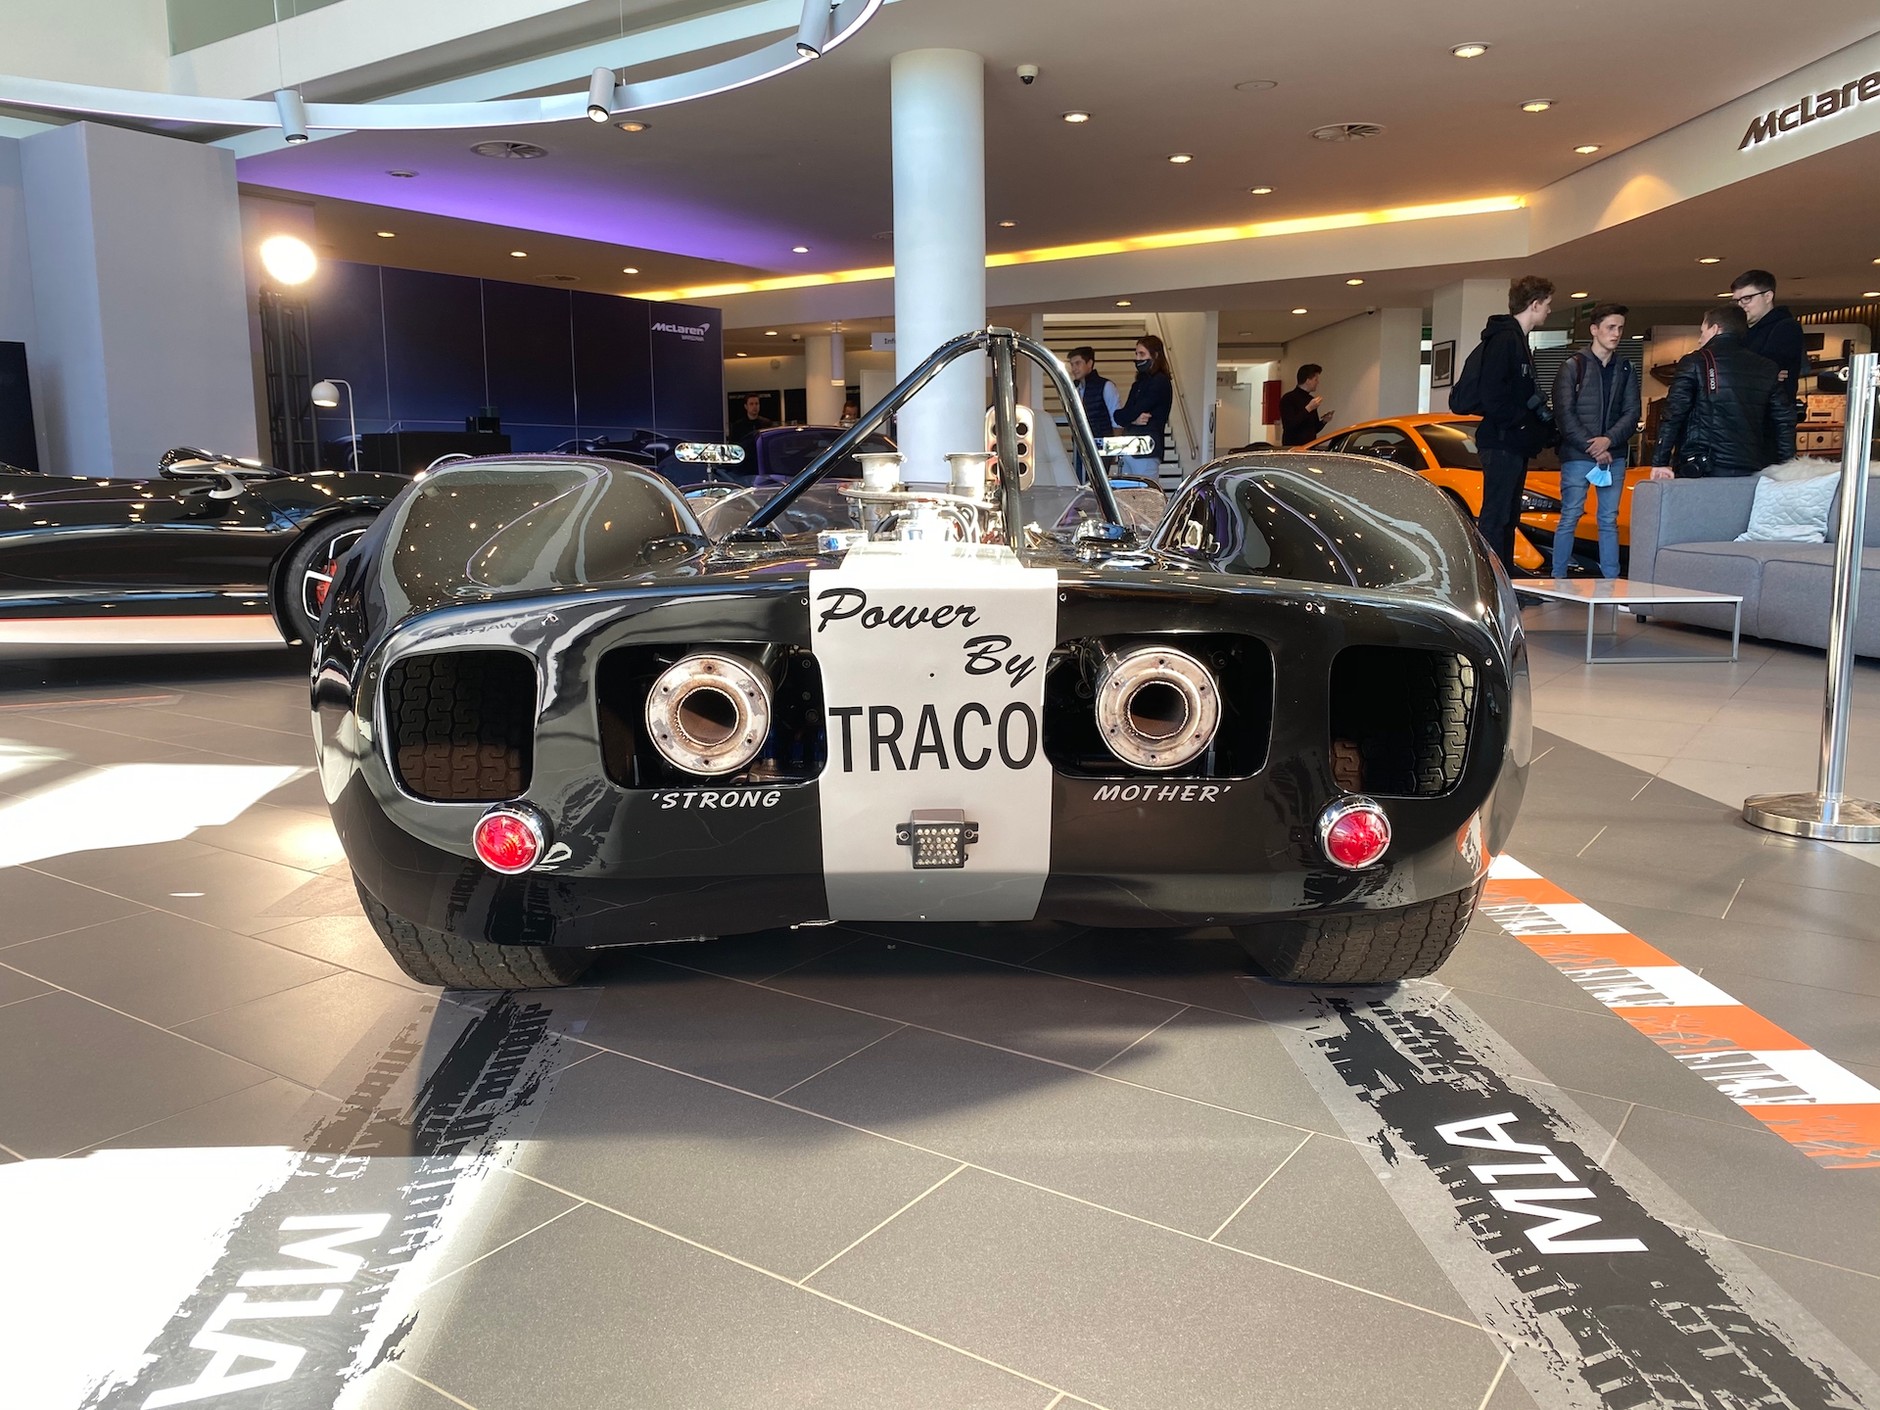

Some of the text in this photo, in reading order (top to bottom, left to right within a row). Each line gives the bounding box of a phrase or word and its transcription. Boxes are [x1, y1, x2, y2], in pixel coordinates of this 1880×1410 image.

[651, 322, 704, 336] McLaren
[817, 587, 980, 632] Power
[963, 635, 1037, 688] By
[829, 702, 1038, 773] TRACO
[652, 791, 781, 809] 'STRONG
[1093, 785, 1232, 802] MOTHER'
